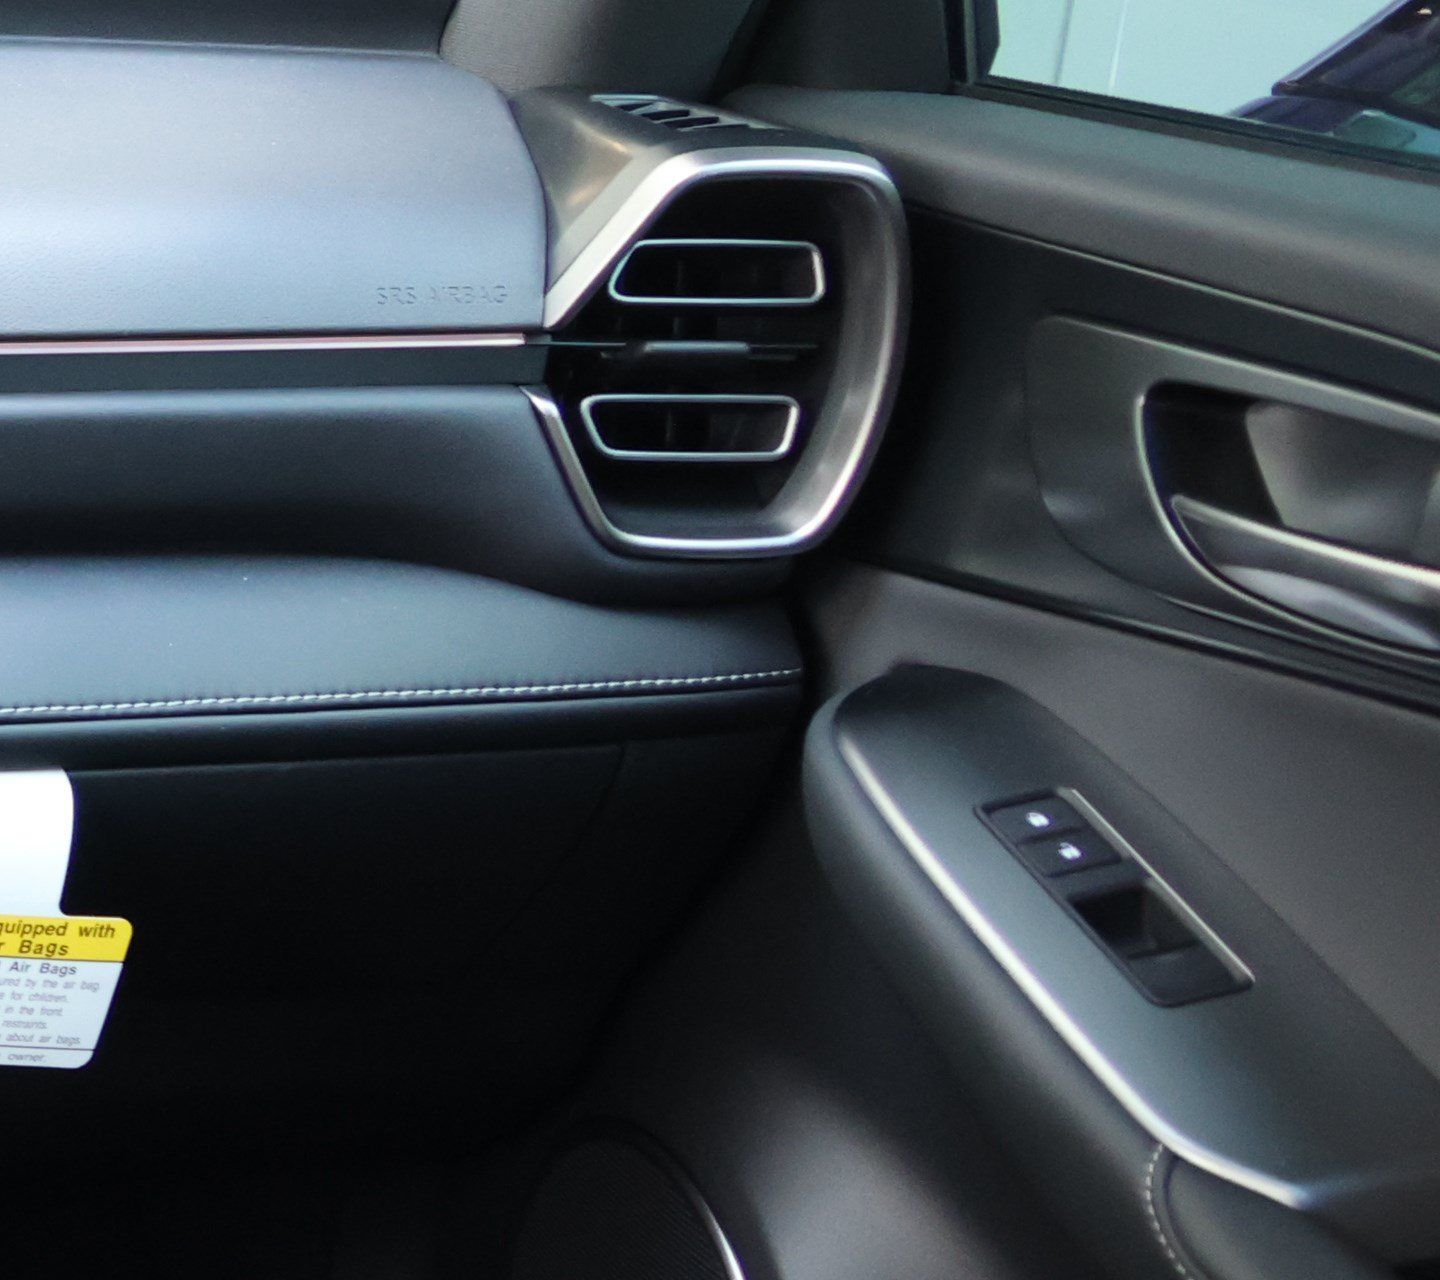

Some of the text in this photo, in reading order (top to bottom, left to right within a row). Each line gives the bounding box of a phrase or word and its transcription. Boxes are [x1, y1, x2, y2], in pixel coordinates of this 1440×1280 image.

[78, 923, 116, 939] with
[18, 940, 70, 958] Bags
[9, 961, 31, 973] Air
[38, 962, 78, 977] Bags
